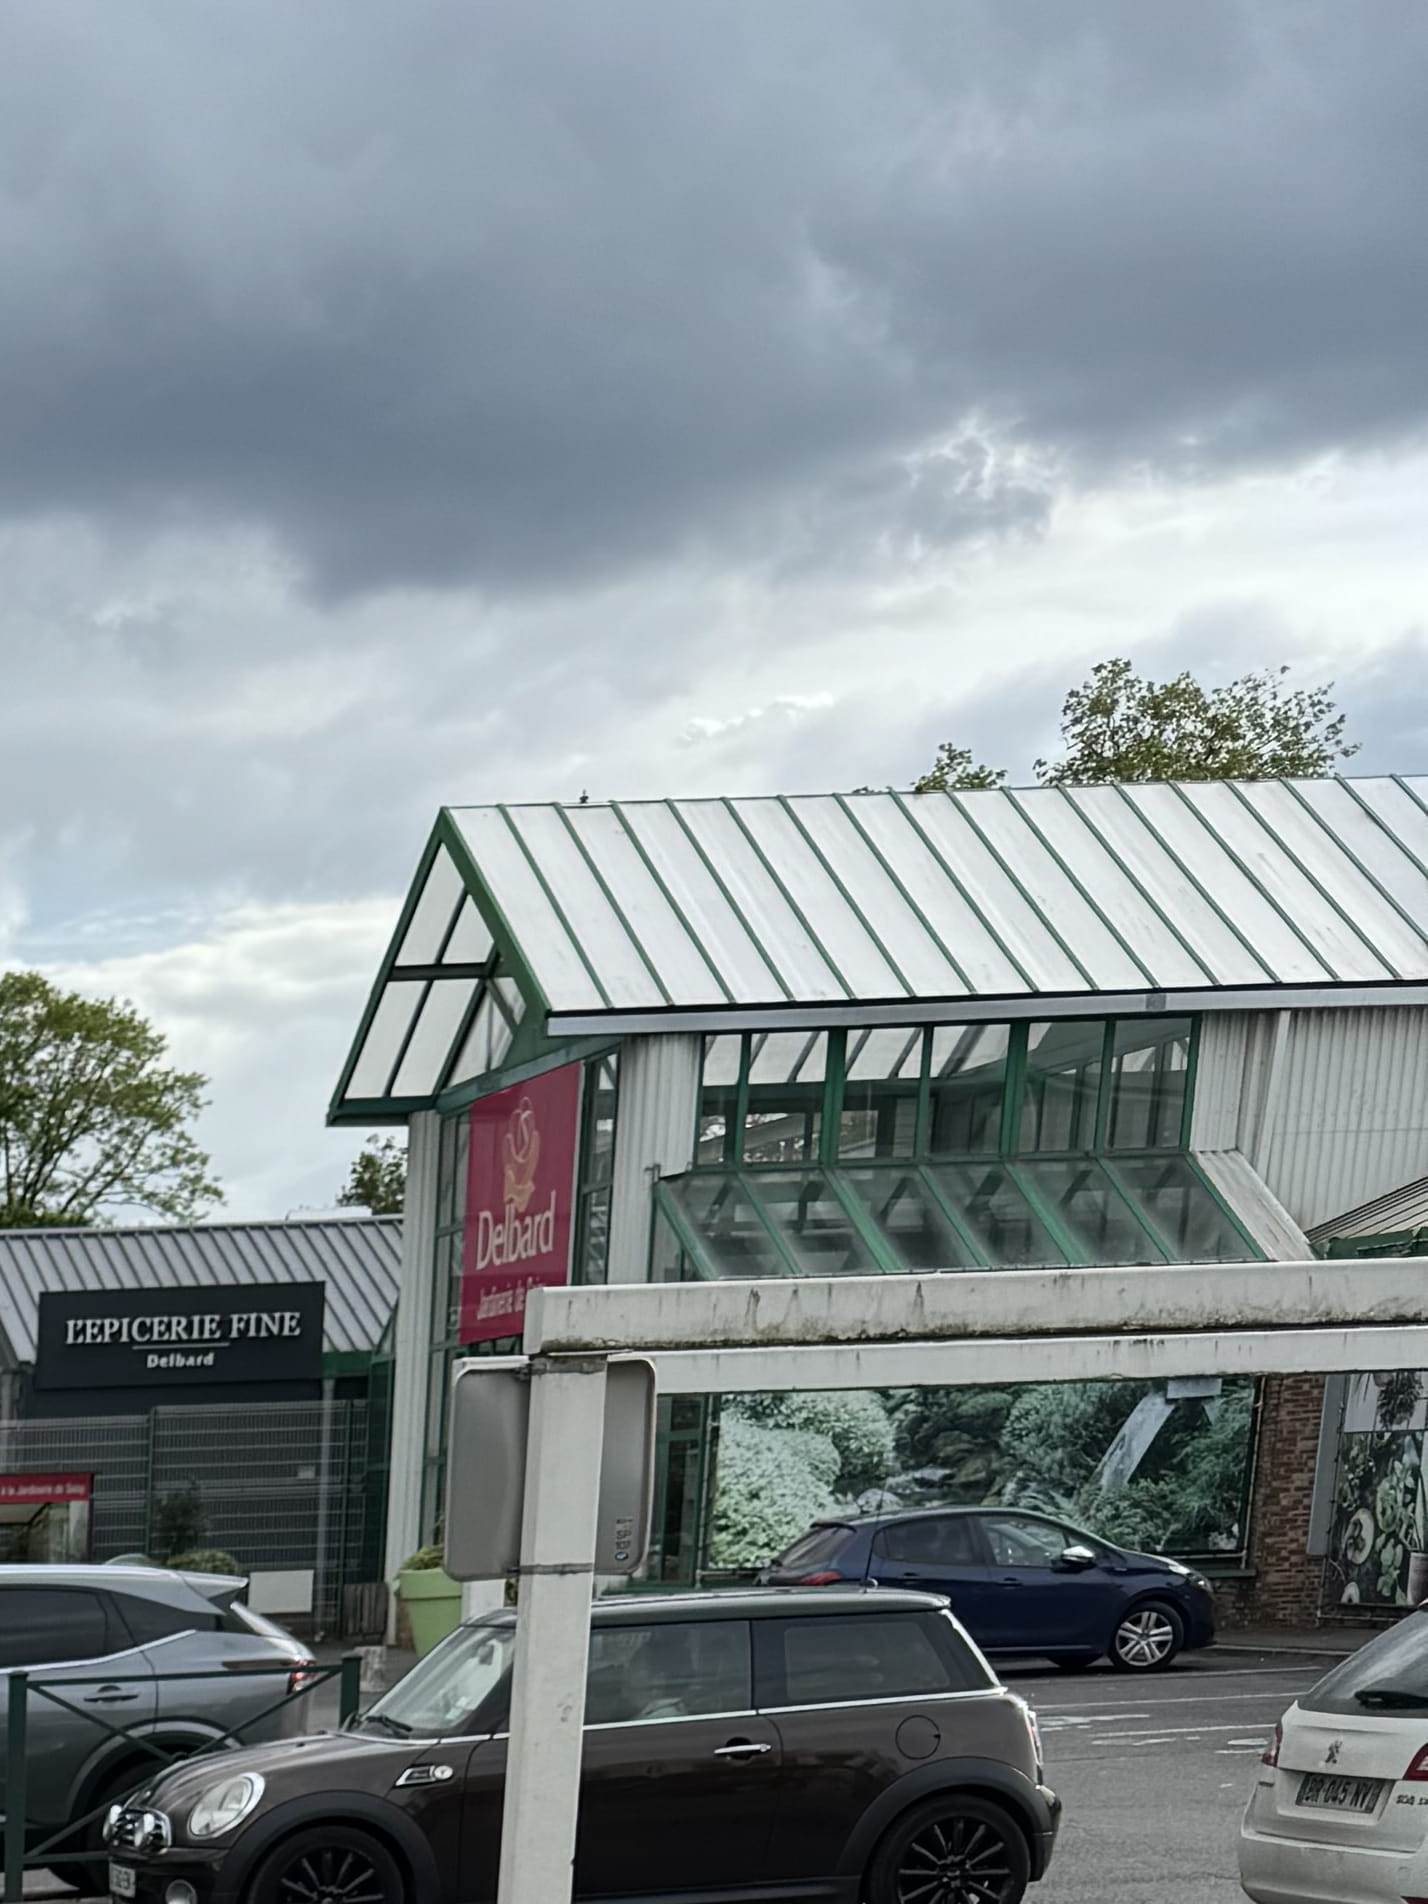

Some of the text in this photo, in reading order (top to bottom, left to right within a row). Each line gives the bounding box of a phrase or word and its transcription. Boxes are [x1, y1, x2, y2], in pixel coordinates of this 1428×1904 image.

[476, 1189, 556, 1270] Delbard
[229, 1312, 301, 1338] FINE
[147, 1352, 215, 1368] Delbard
